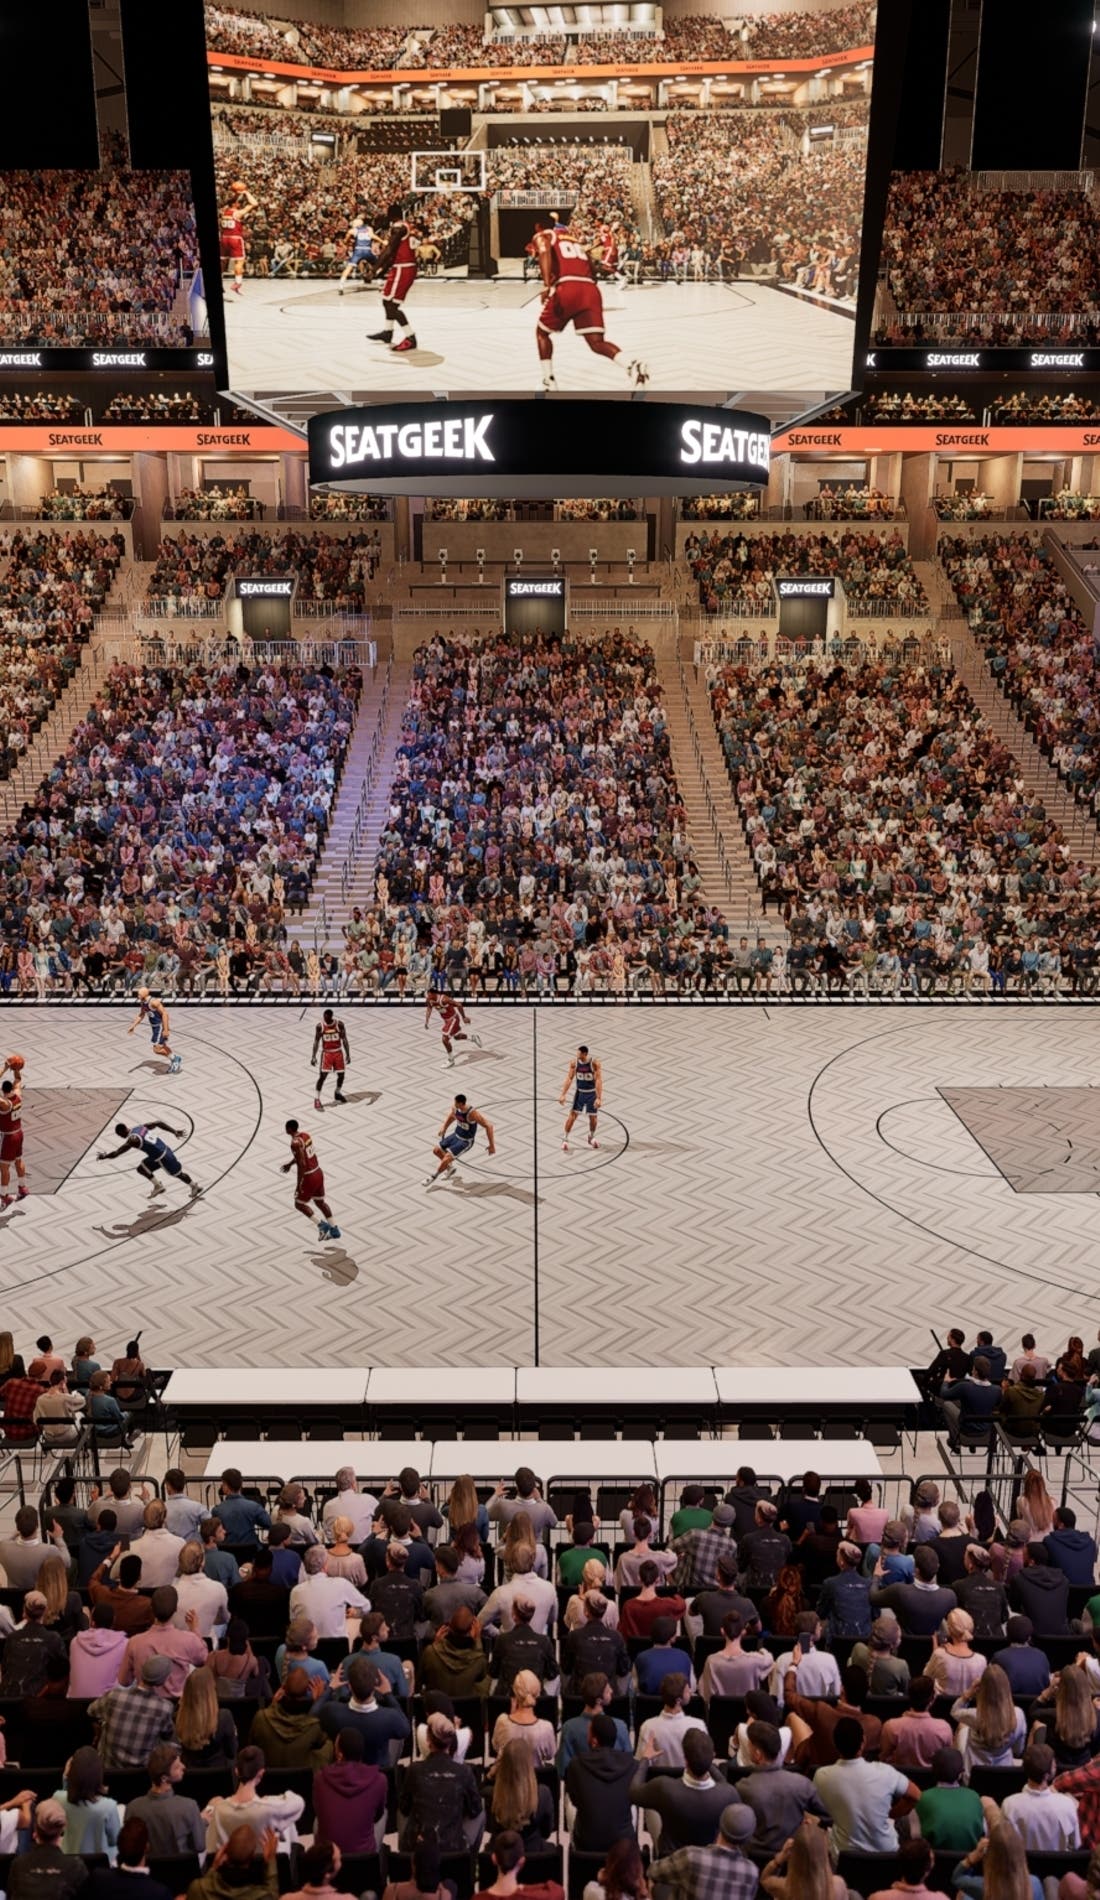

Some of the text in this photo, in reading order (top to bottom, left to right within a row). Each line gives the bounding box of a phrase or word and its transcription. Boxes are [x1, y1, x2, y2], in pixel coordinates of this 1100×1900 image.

[93, 352, 146, 366] SEATGEEK
[927, 353, 980, 366] SEATGEEK
[1031, 353, 1084, 366] SEATGEEK
[49, 433, 103, 445] SEATGEEK
[197, 433, 251, 446] SEATGEEK
[329, 414, 496, 468] SEATGEEK
[788, 433, 842, 446] SEATGEEK
[936, 433, 989, 446] SEATGEEK
[240, 582, 291, 594] SEATGEEK
[510, 582, 561, 594] SEATGEEK
[780, 582, 831, 594] SEATGEEK
